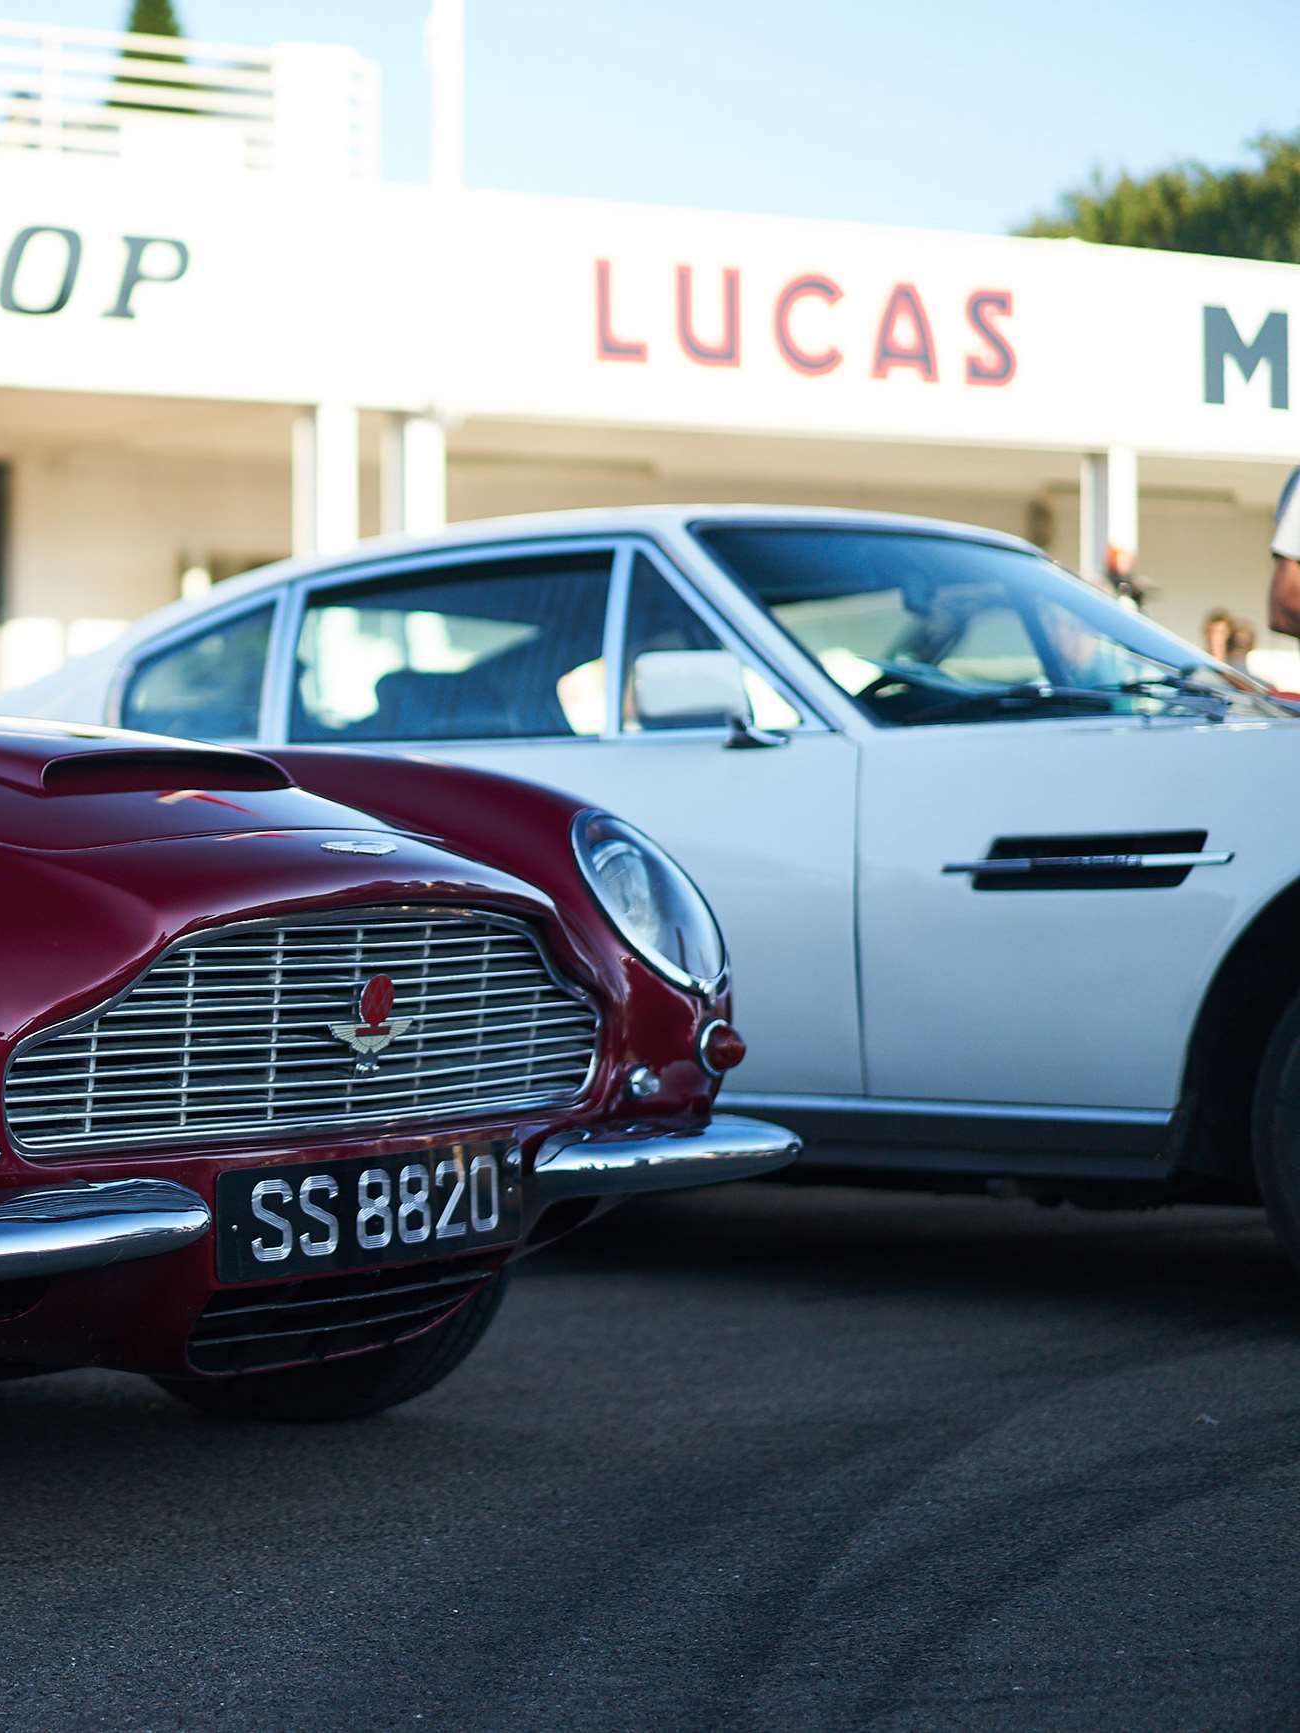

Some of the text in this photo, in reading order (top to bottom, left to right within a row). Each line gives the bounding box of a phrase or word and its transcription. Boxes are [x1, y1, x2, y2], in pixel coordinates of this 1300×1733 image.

[595, 258, 1018, 387] LUCAS
[1203, 305, 1289, 411] M
[250, 1155, 499, 1262] SS 8820
